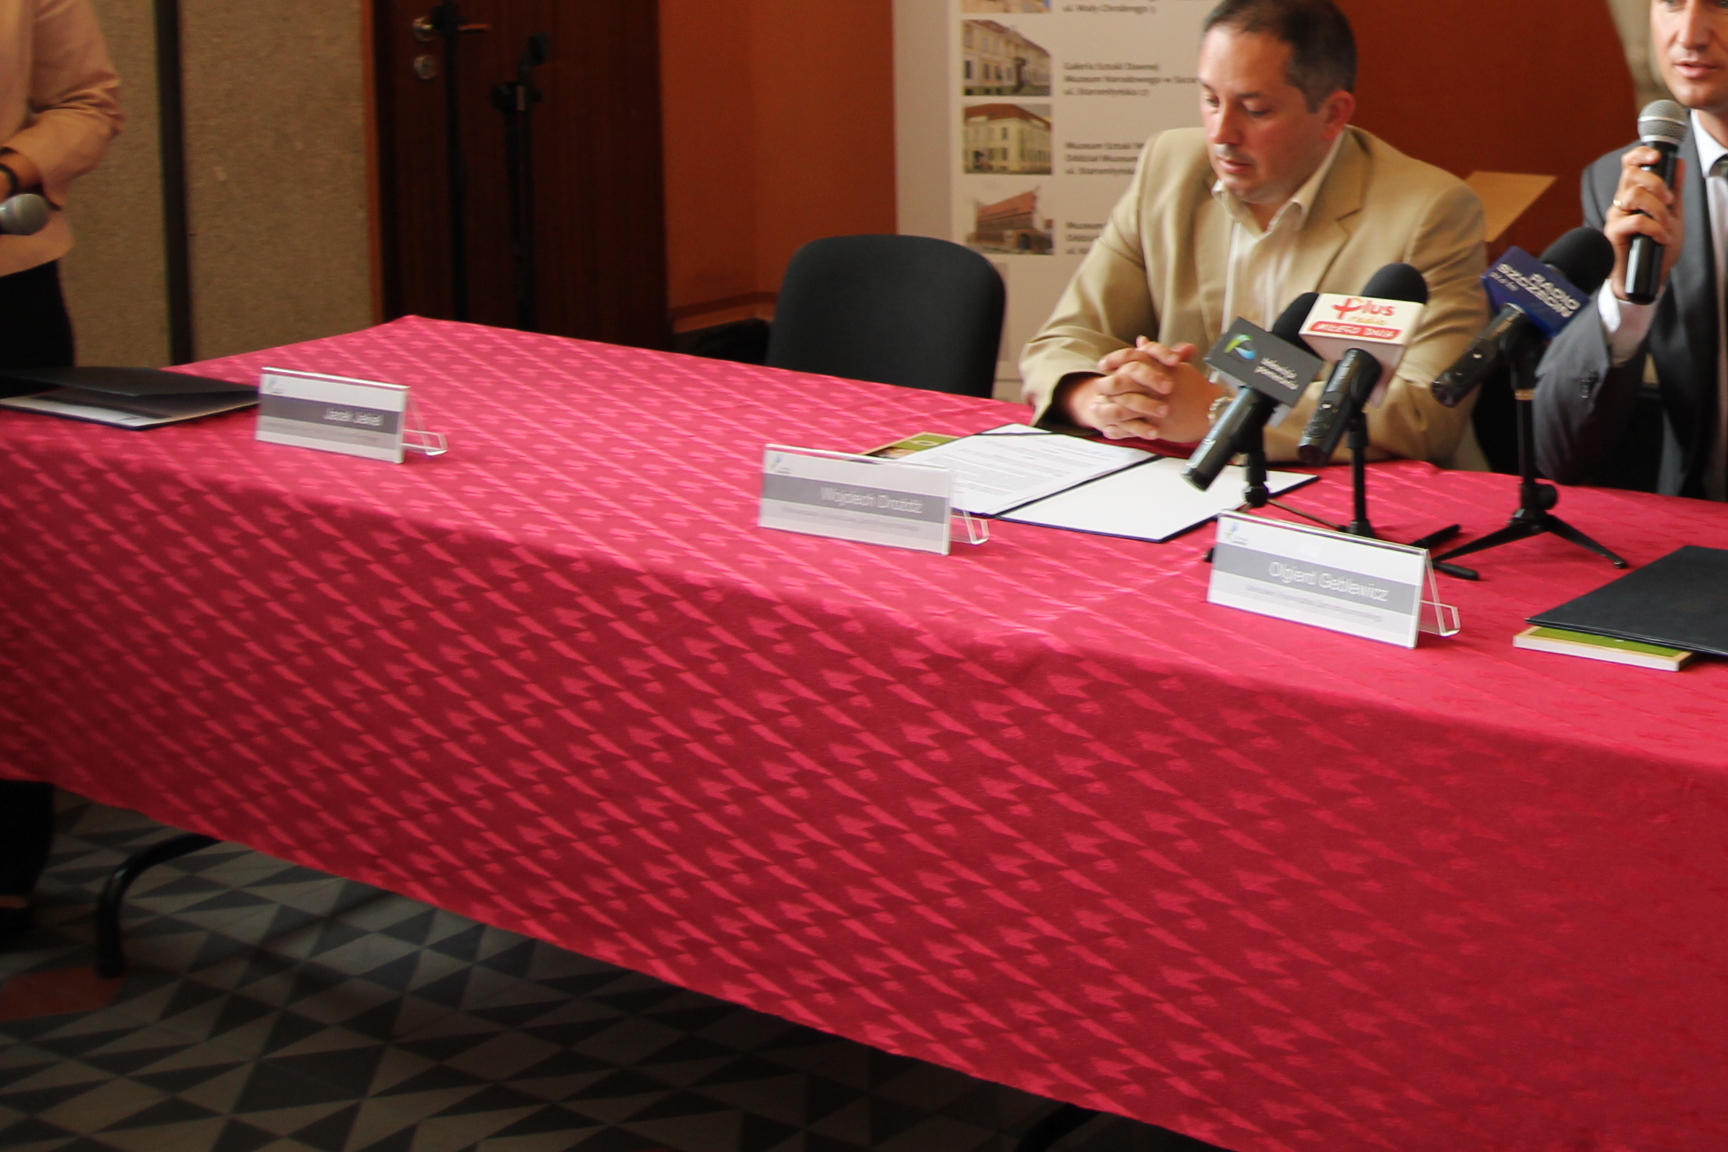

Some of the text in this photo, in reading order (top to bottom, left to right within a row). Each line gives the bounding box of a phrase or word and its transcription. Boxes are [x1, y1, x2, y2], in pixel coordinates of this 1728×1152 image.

[1495, 262, 1575, 319] SZCZECIN
[1530, 272, 1581, 310] RADIO
[1349, 315, 1388, 325] radio
[819, 485, 875, 508] Wojciech
[1267, 559, 1318, 586] Olgierd
